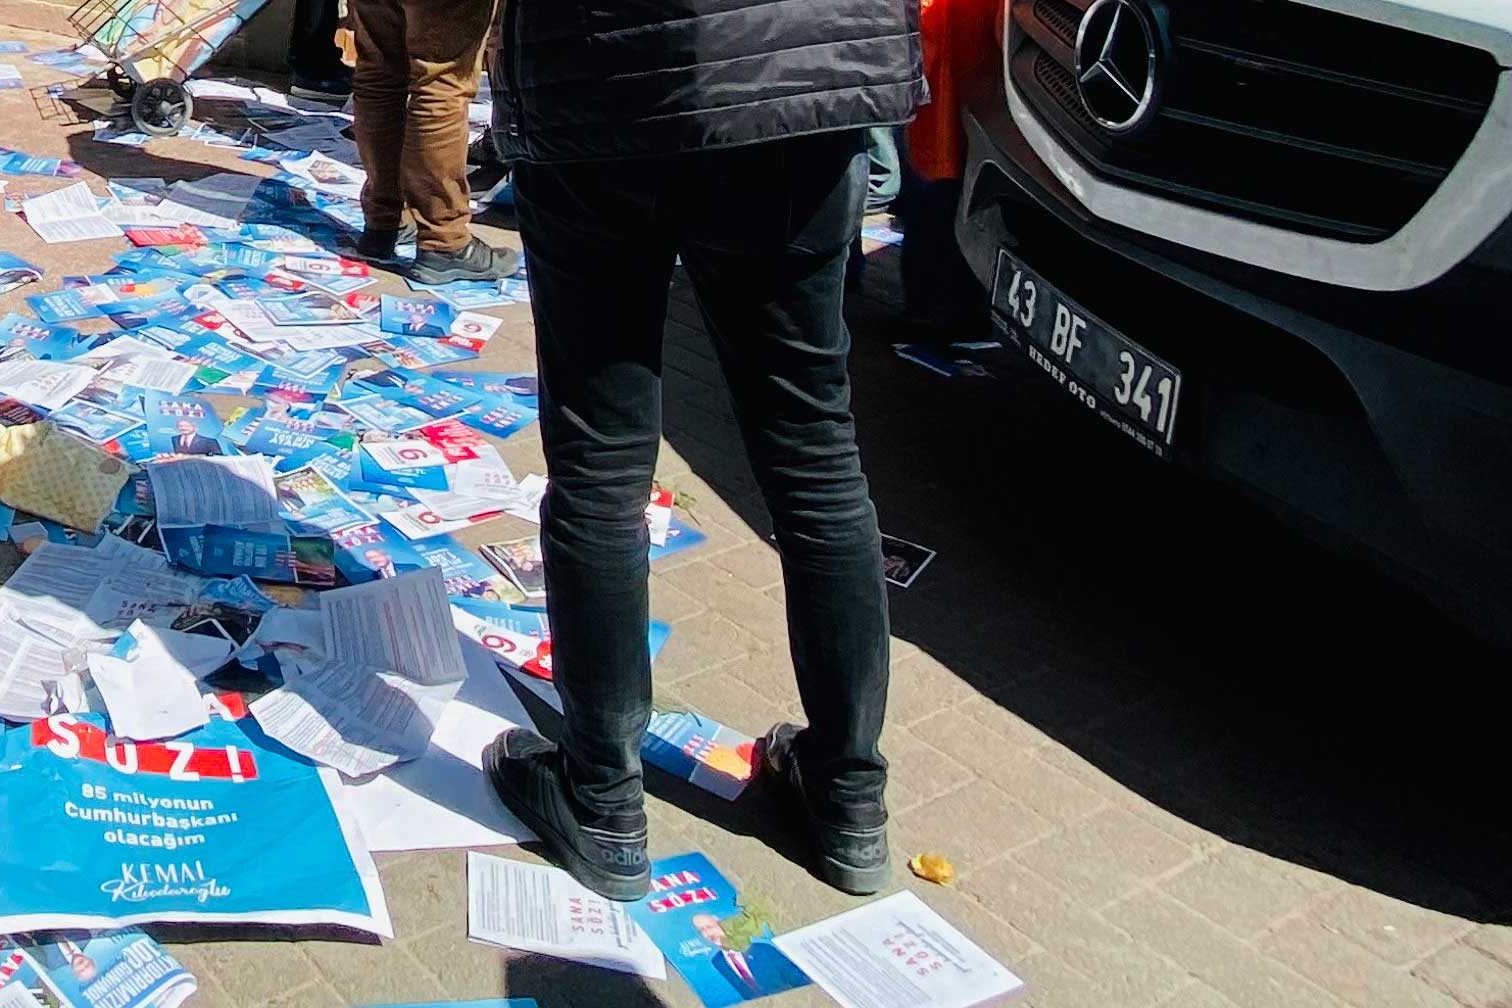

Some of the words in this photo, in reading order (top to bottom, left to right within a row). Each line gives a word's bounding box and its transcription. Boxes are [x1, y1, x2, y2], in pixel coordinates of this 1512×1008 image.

[1008, 270, 1037, 328] 43
[1050, 303, 1087, 364] BF
[1114, 351, 1172, 433] 341
[1068, 381, 1097, 410] OTO
[81, 783, 108, 801] 85
[112, 790, 215, 811] milyonun
[65, 800, 238, 830] Cumhurbaşkanı
[103, 828, 206, 850] olacağım
[650, 870, 701, 893] ANA
[569, 896, 585, 933] SANA
